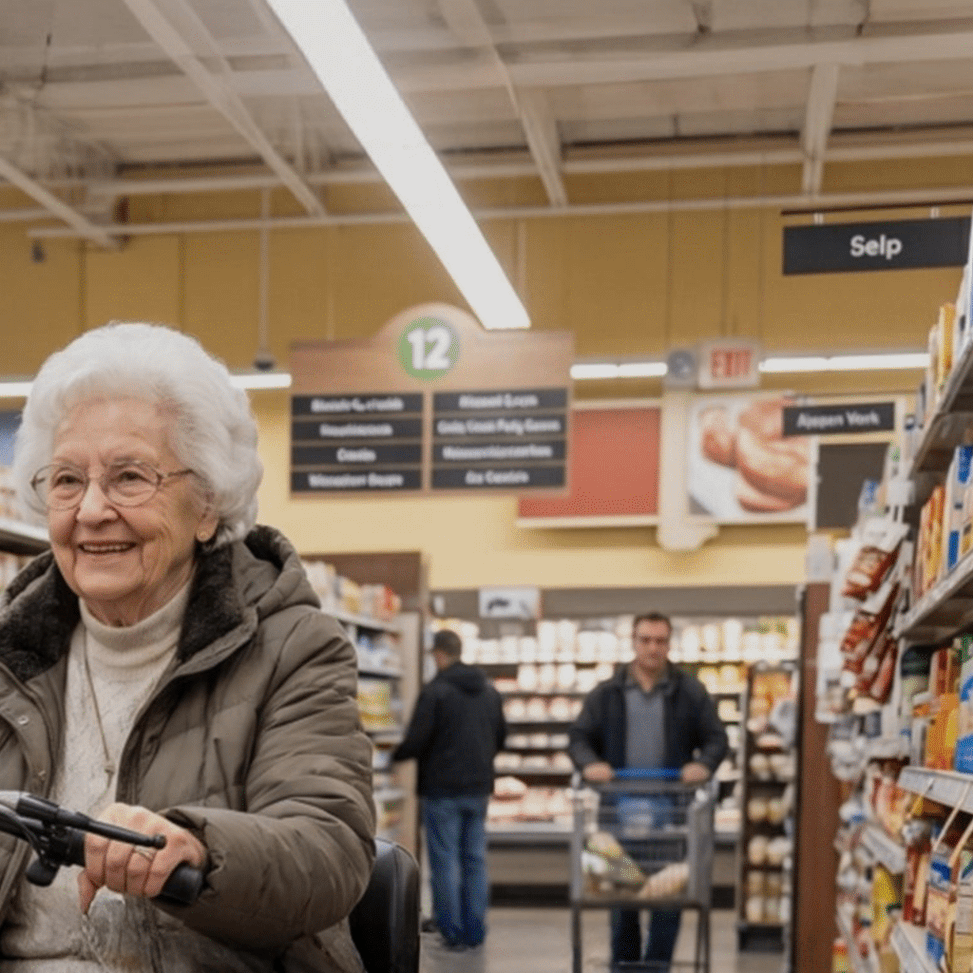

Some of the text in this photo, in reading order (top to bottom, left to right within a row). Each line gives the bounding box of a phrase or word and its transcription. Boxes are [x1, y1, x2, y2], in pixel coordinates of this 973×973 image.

[849, 234, 903, 260] Selp
[407, 326, 451, 370] 12
[710, 349, 752, 378] EXIT
